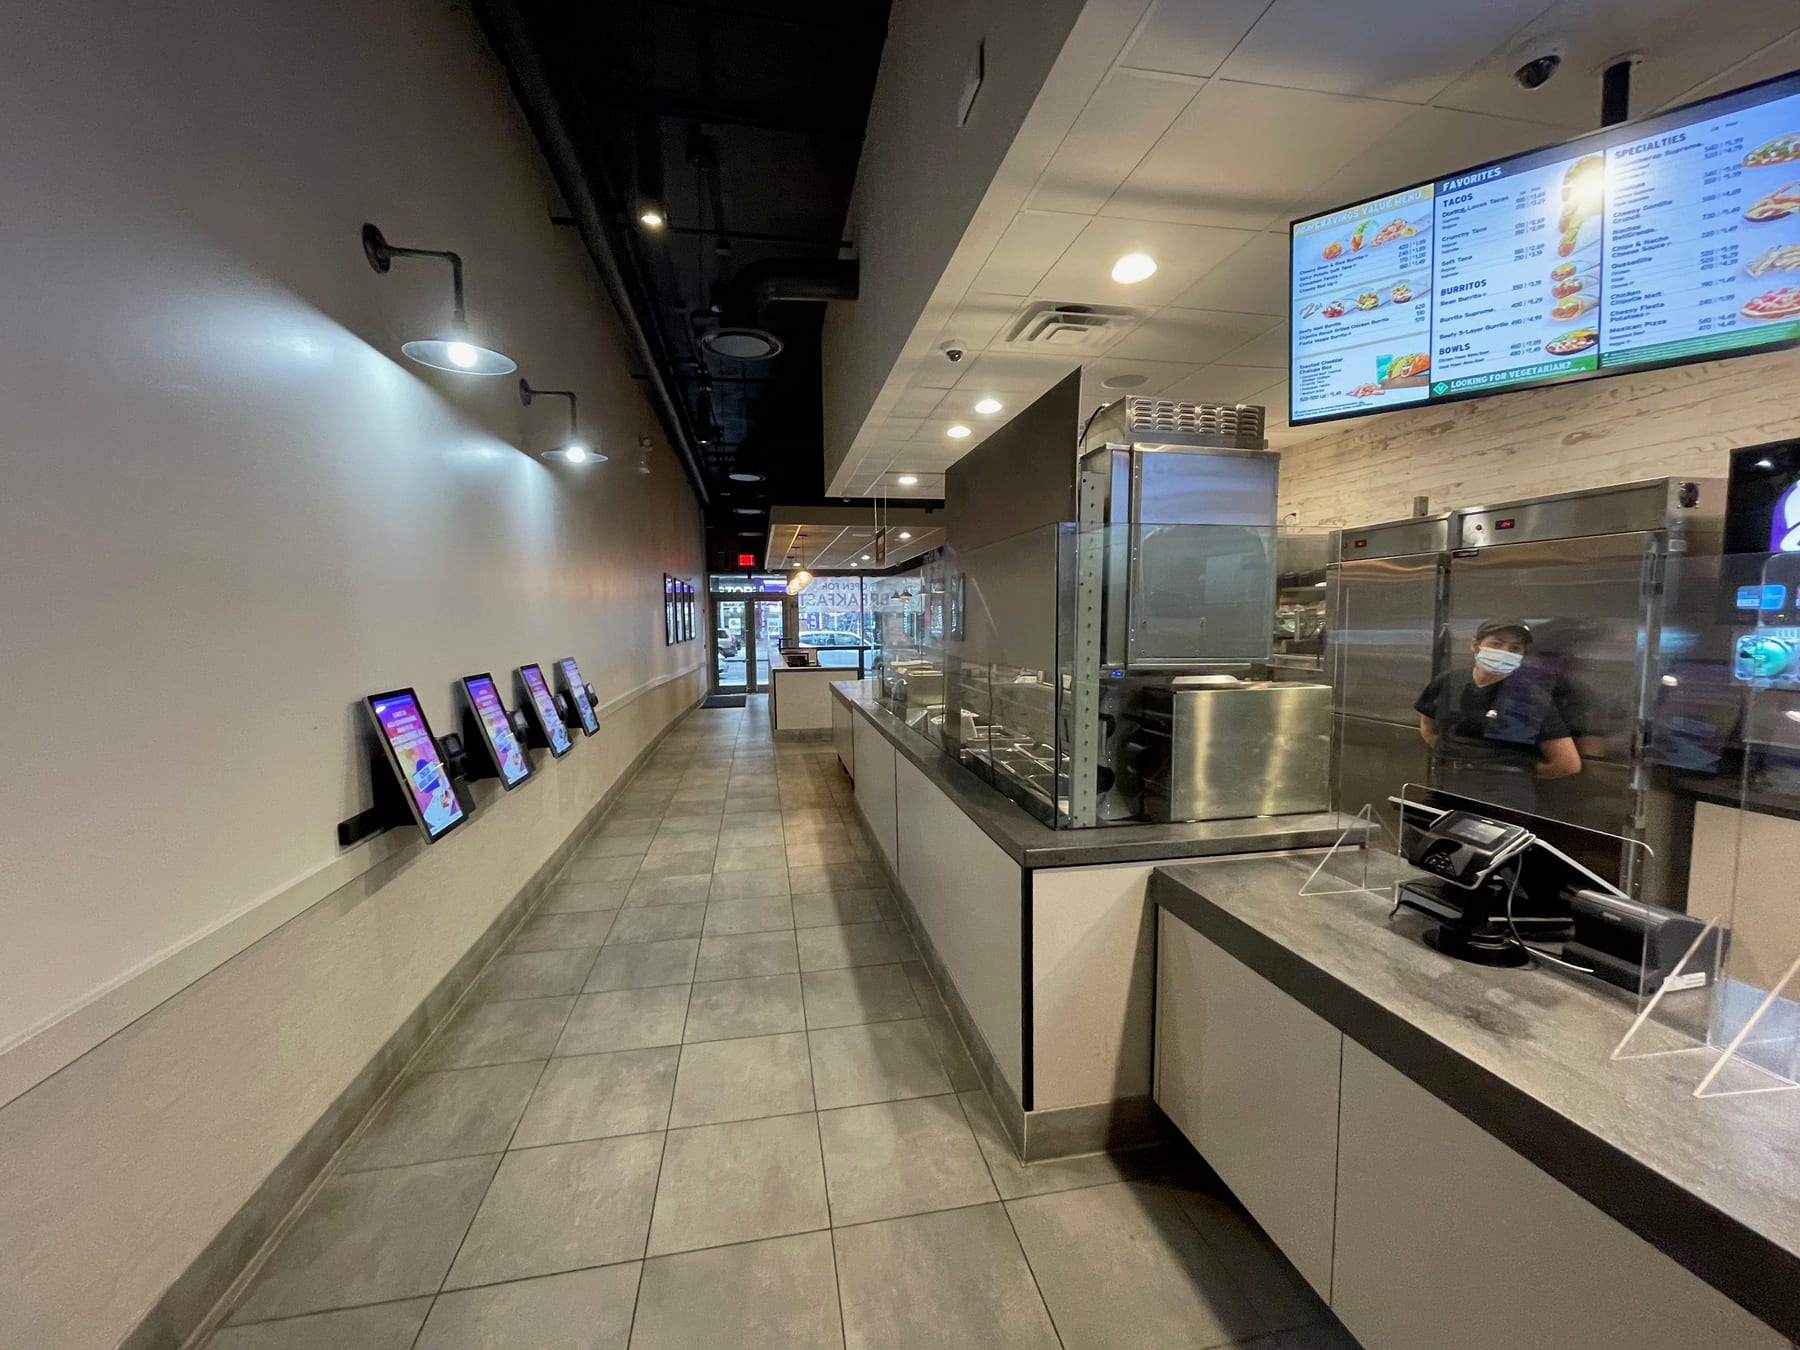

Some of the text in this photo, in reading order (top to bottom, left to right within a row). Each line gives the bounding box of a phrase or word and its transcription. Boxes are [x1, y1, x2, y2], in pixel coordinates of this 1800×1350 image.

[1615, 133, 1686, 159] SPECIALTIES
[1442, 167, 1501, 191] FAVORITES
[1443, 193, 1472, 207] TACOS
[1440, 280, 1486, 296] BURRITOS
[1439, 343, 1470, 355] BOWLS
[1450, 376, 1488, 388] LOOKING
[1510, 361, 1571, 378] VEGETARIAN?
